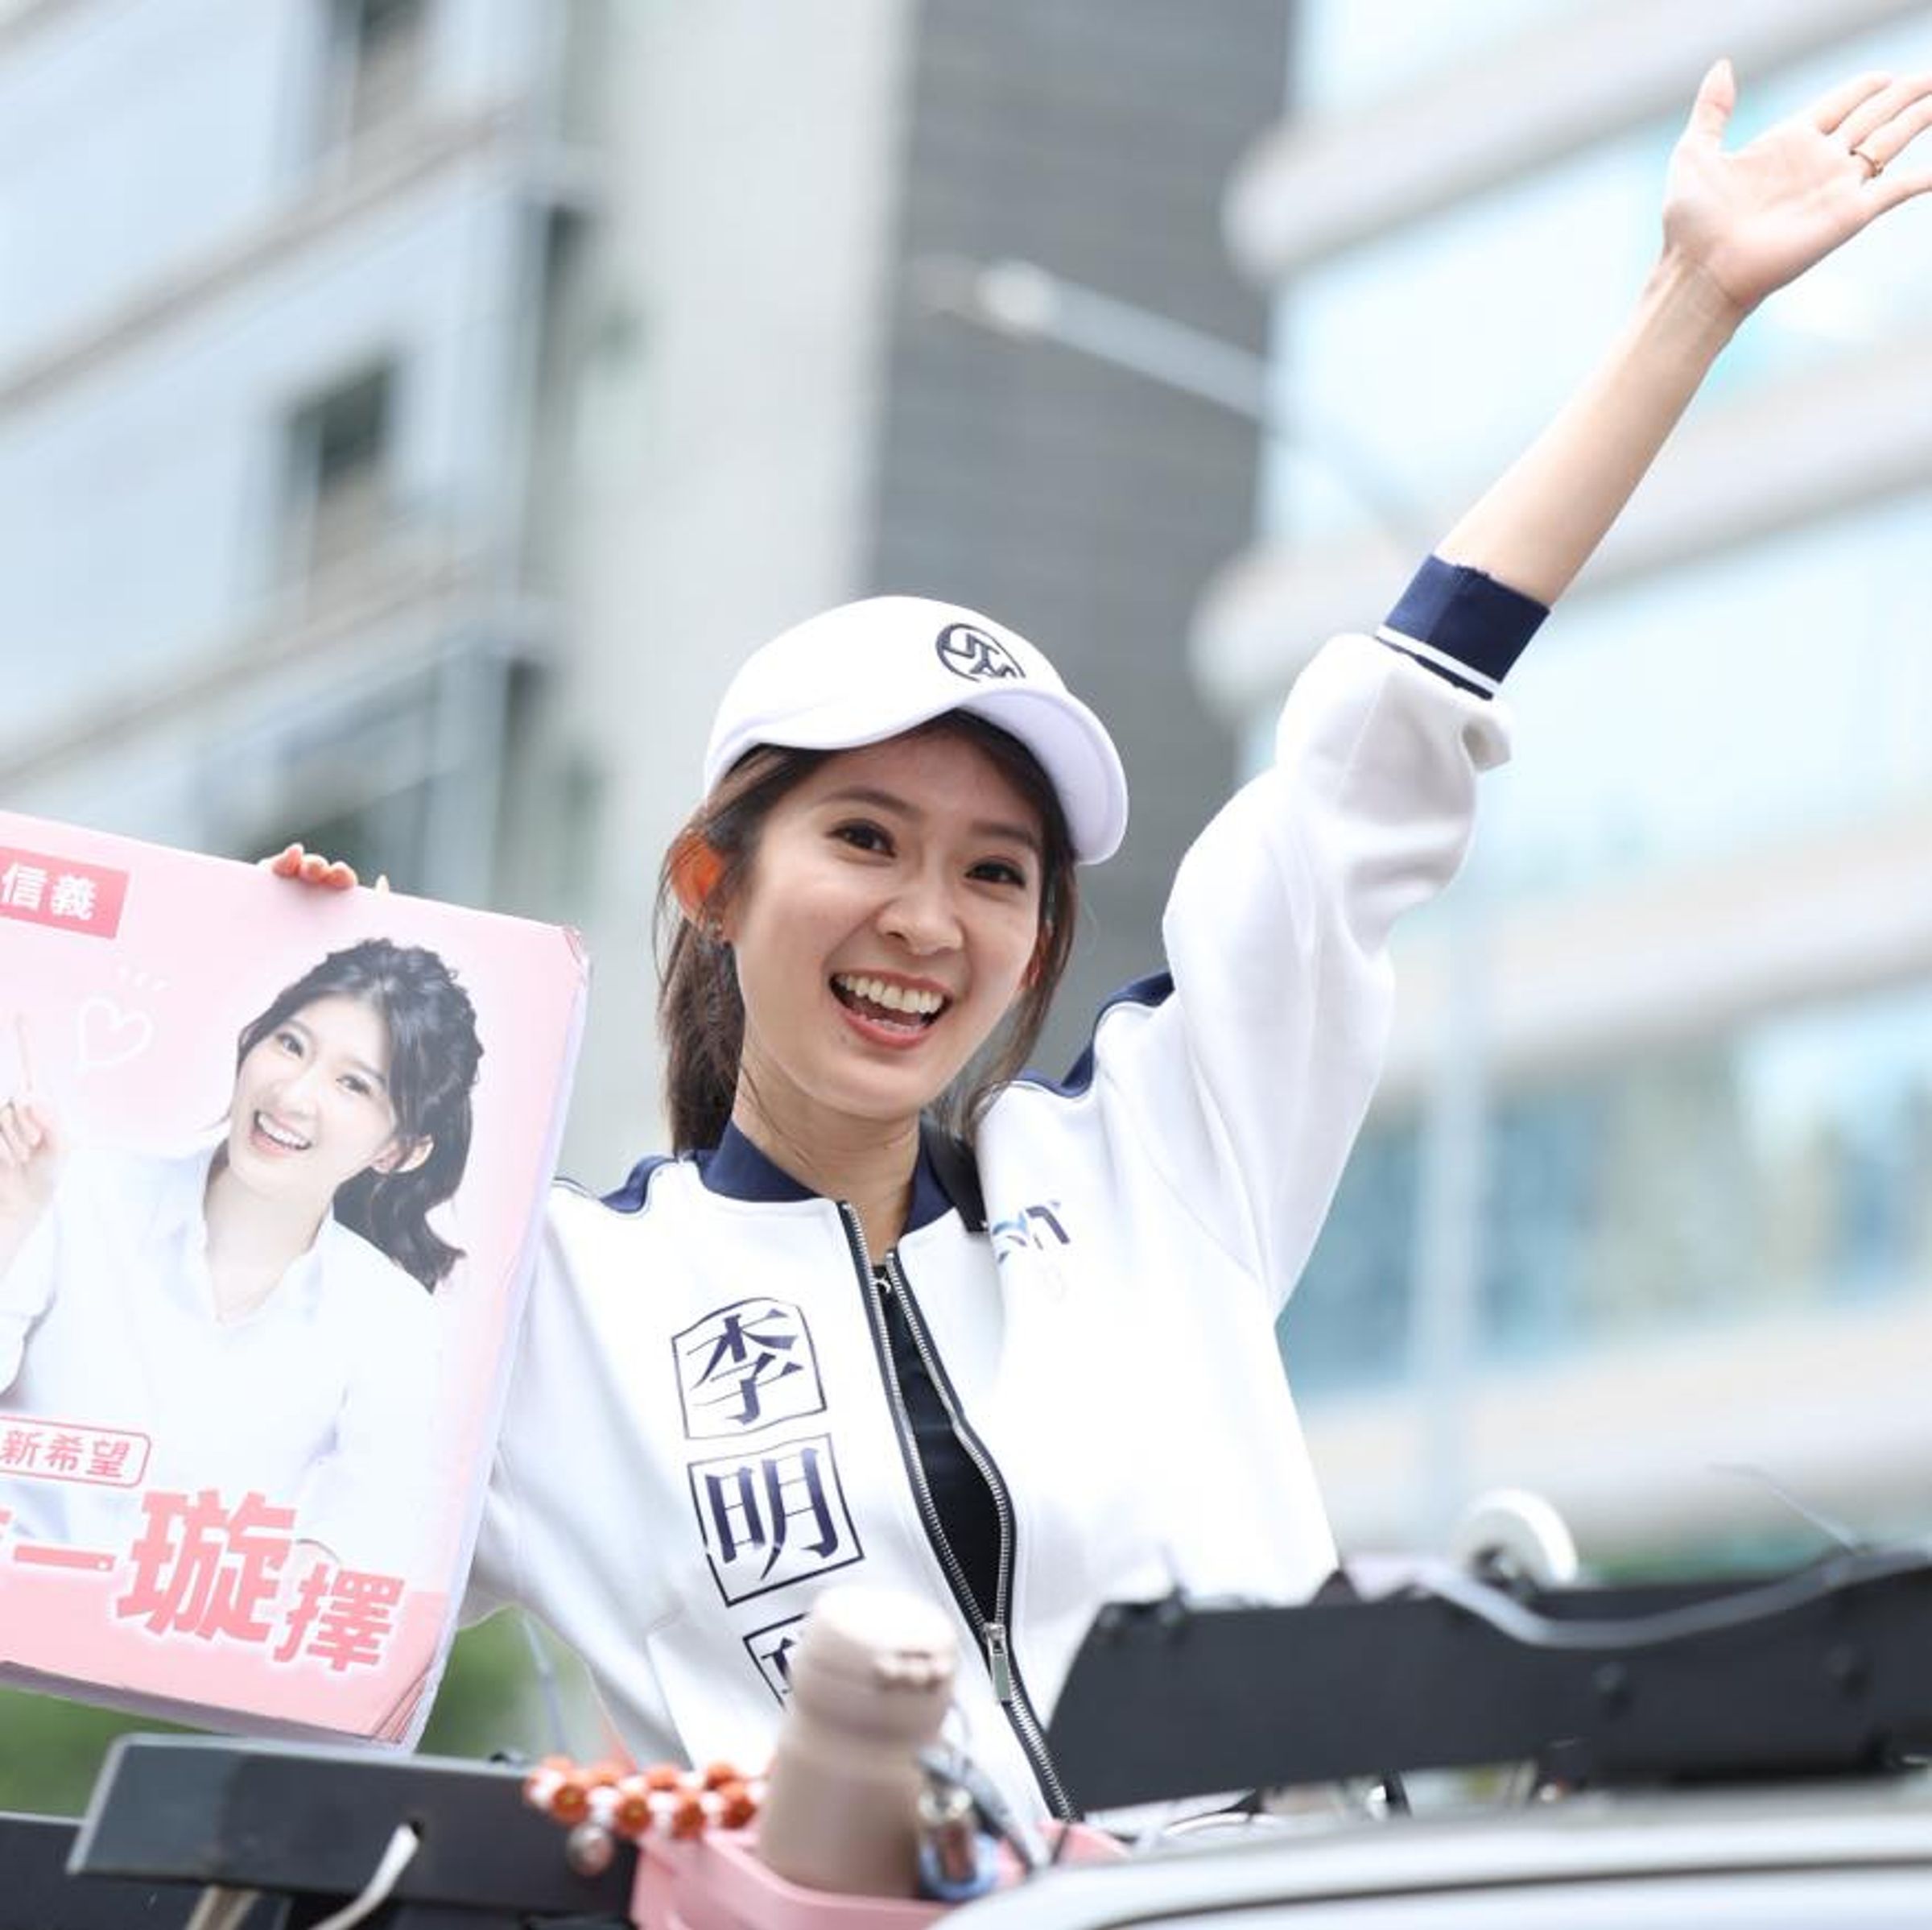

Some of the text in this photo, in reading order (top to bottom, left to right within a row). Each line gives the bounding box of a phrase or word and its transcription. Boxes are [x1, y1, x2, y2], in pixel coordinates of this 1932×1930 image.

[1, 862, 97, 921] 信義
[0, 1429, 130, 1479] 新希望
[685, 1308, 840, 1696] 李明
